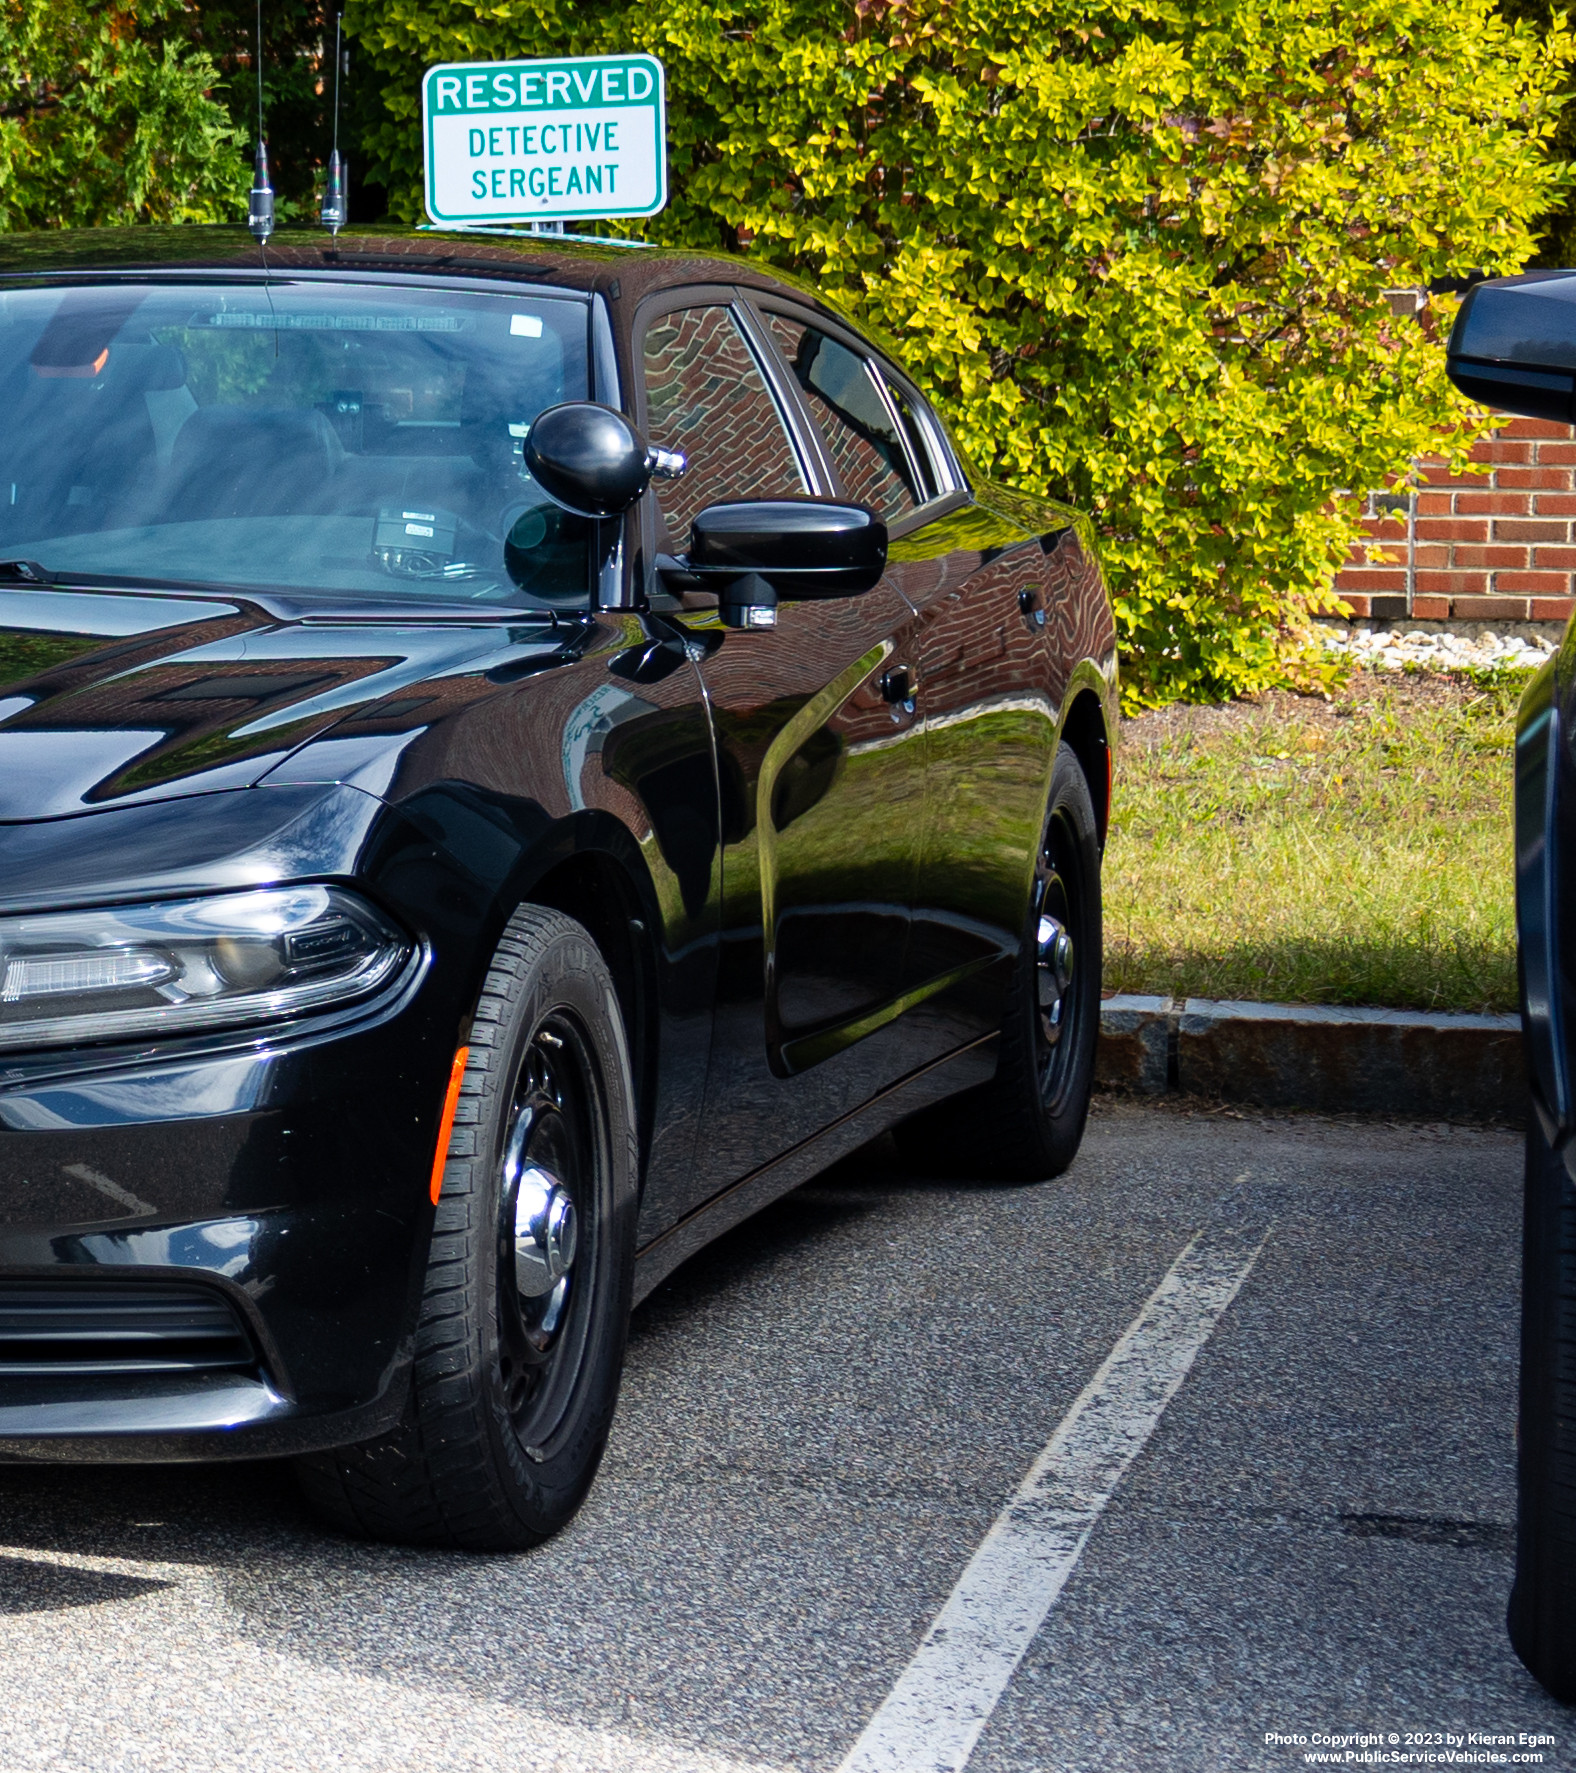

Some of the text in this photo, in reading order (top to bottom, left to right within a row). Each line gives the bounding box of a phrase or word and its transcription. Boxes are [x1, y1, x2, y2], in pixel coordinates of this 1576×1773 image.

[436, 66, 654, 110] RESERVED
[469, 122, 620, 157] DETECTIVE
[471, 164, 620, 199] SERGEANT
